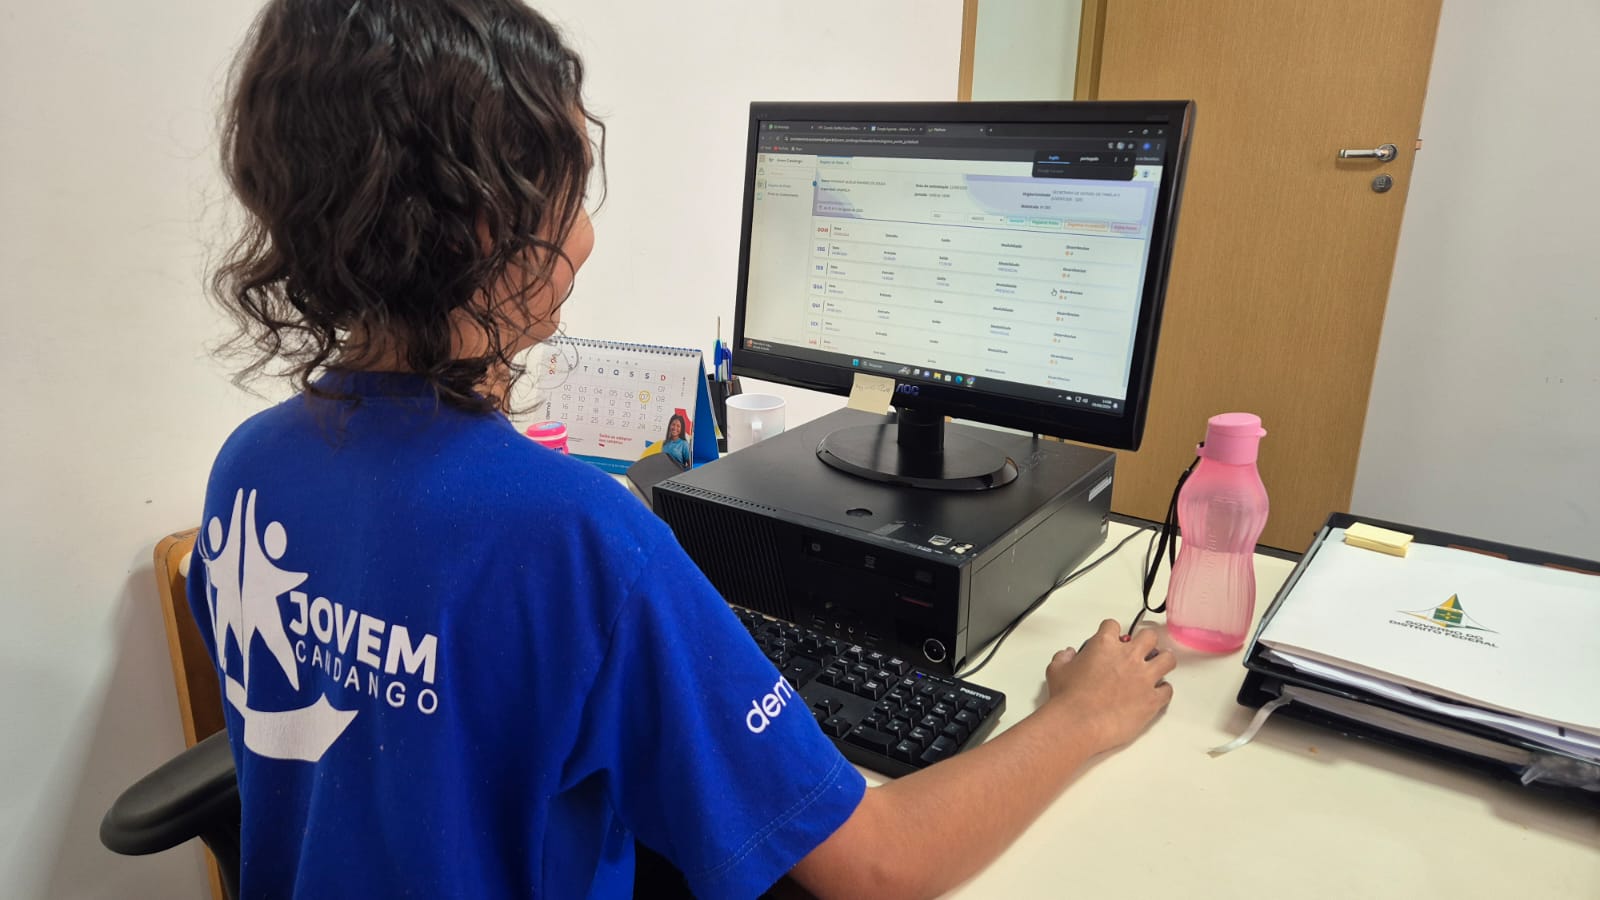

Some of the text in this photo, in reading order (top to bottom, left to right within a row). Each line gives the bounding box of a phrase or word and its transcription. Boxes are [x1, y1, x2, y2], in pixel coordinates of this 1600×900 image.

[645, 372, 650, 380] S
[660, 374, 666, 382] D
[896, 383, 920, 396] AOC
[289, 590, 438, 684] JOVEM
[1388, 620, 1500, 648] DISTRITO FEDERAL
[1405, 620, 1484, 641] GOVERNO DO
[295, 640, 438, 714] CANDANGO
[960, 686, 992, 701] POSITIVO
